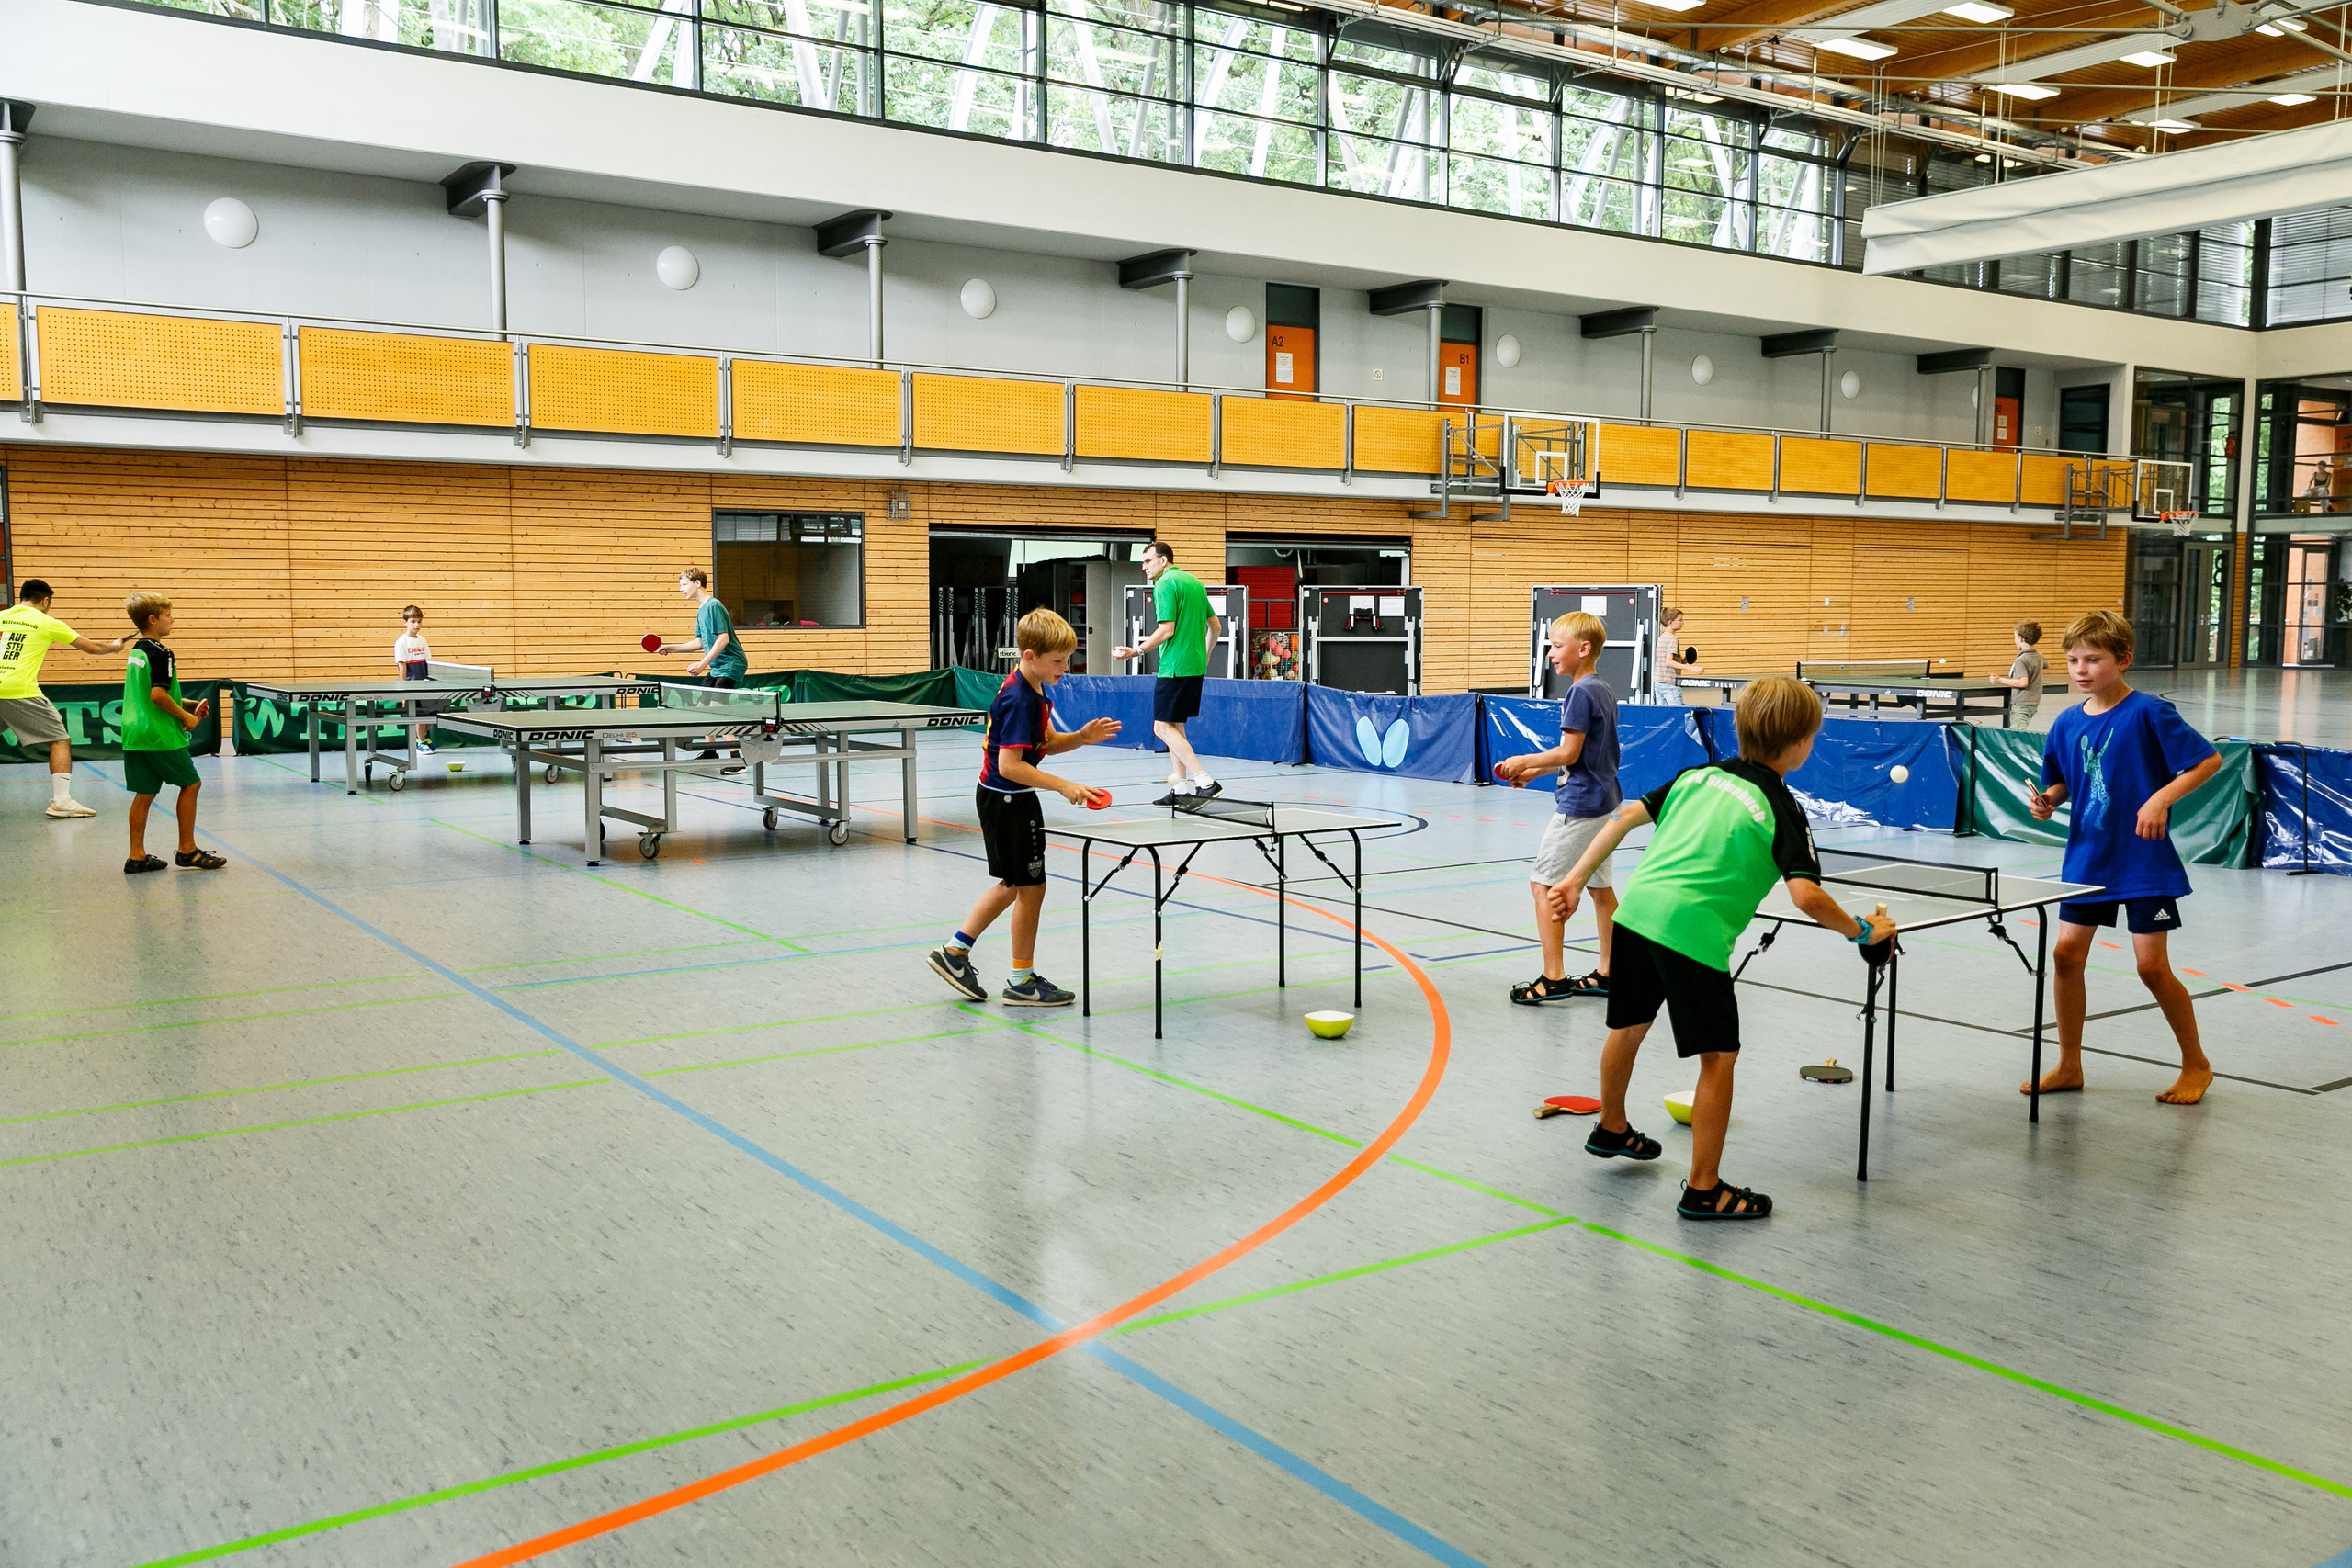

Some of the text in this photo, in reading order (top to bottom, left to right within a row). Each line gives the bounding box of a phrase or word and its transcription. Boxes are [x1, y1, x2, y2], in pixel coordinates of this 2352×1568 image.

[1272, 335, 1283, 347] A2
[1459, 354, 1470, 365] B1
[8, 632, 27, 643] AUF
[6, 642, 24, 652] STEI
[3, 650, 20, 660] GER
[1680, 679, 1711, 687] DONIC
[298, 694, 350, 702] DONIC
[1916, 689, 1953, 698] DONIC
[927, 716, 980, 727] DONIC
[492, 728, 514, 740] DONIC
[527, 730, 595, 741] DONIC
